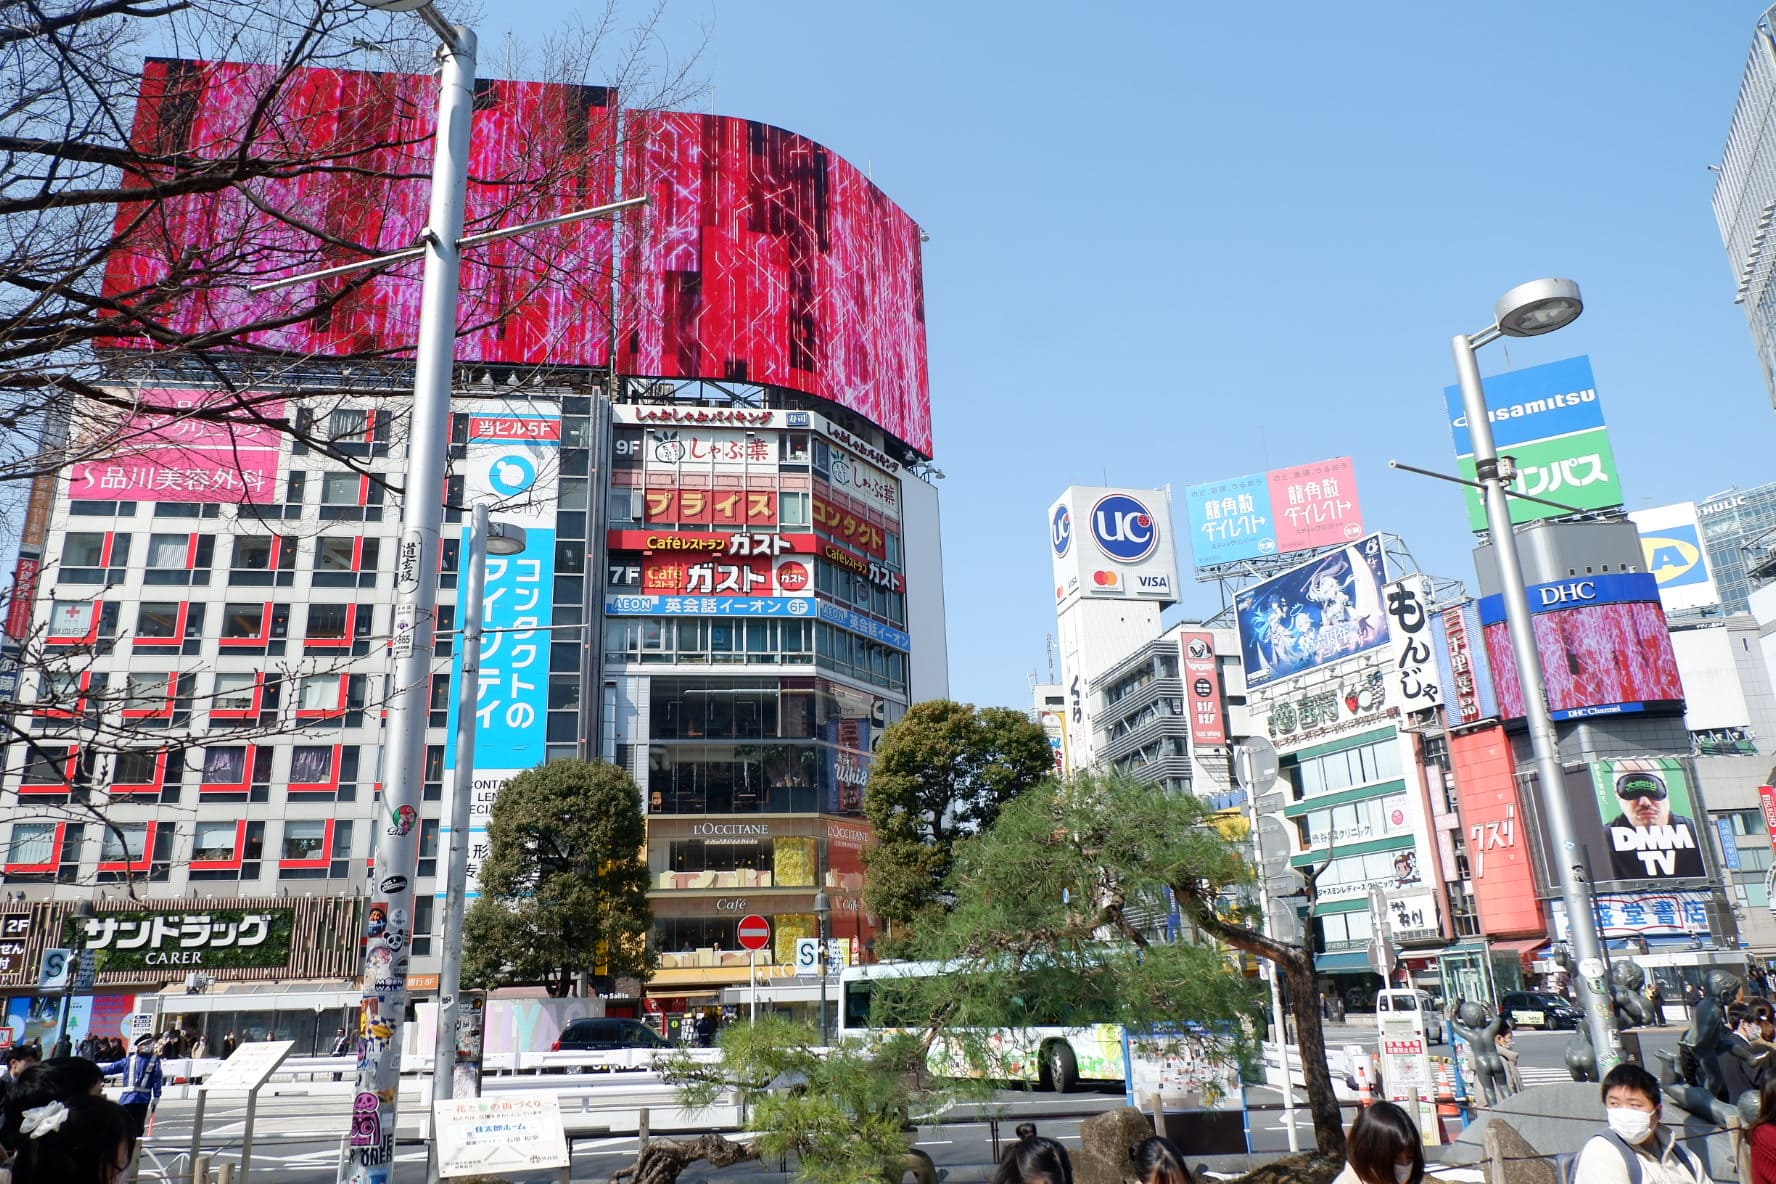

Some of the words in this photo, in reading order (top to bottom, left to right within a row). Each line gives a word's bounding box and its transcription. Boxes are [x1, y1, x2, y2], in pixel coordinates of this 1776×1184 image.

[636, 407, 773, 424] しゃぶしゃぶバイキング
[478, 420, 551, 436] 当ビル5F
[615, 439, 640, 455] 9F
[690, 437, 768, 462] しゃぶ葉
[100, 468, 266, 493] 品川美容外科
[853, 463, 896, 506] しゃぶ葉
[647, 492, 776, 518] プライス
[1703, 496, 1746, 515] HULIC
[813, 500, 882, 550] コンタクト
[729, 533, 791, 556] ガスト
[400, 543, 417, 582] 道玄坂
[648, 566, 682, 581] Café
[609, 566, 640, 584] 7F
[685, 564, 766, 593] ガスト
[780, 574, 805, 583] ガスト
[868, 561, 900, 590] ガスト
[1140, 576, 1167, 587] VISA
[614, 597, 652, 612] AEON
[1540, 581, 1597, 605] DHC
[665, 598, 781, 614] 英会話イーオン
[790, 600, 808, 614] 6F
[850, 613, 909, 647] 英会話イーオン
[505, 559, 541, 728] コンタクトの
[1388, 582, 1438, 702] もんじゃ
[1568, 709, 1587, 718] DHC
[1587, 704, 1622, 715] Channel
[694, 822, 769, 835] L'OCCITANE
[1611, 823, 1696, 852] DMM
[1637, 850, 1676, 876] TV
[717, 898, 747, 913] Café
[1565, 899, 1706, 928] 盛堂書店
[7, 919, 30, 933] 2F
[84, 914, 272, 949] サンドラッグ
[146, 951, 202, 966] CARER
